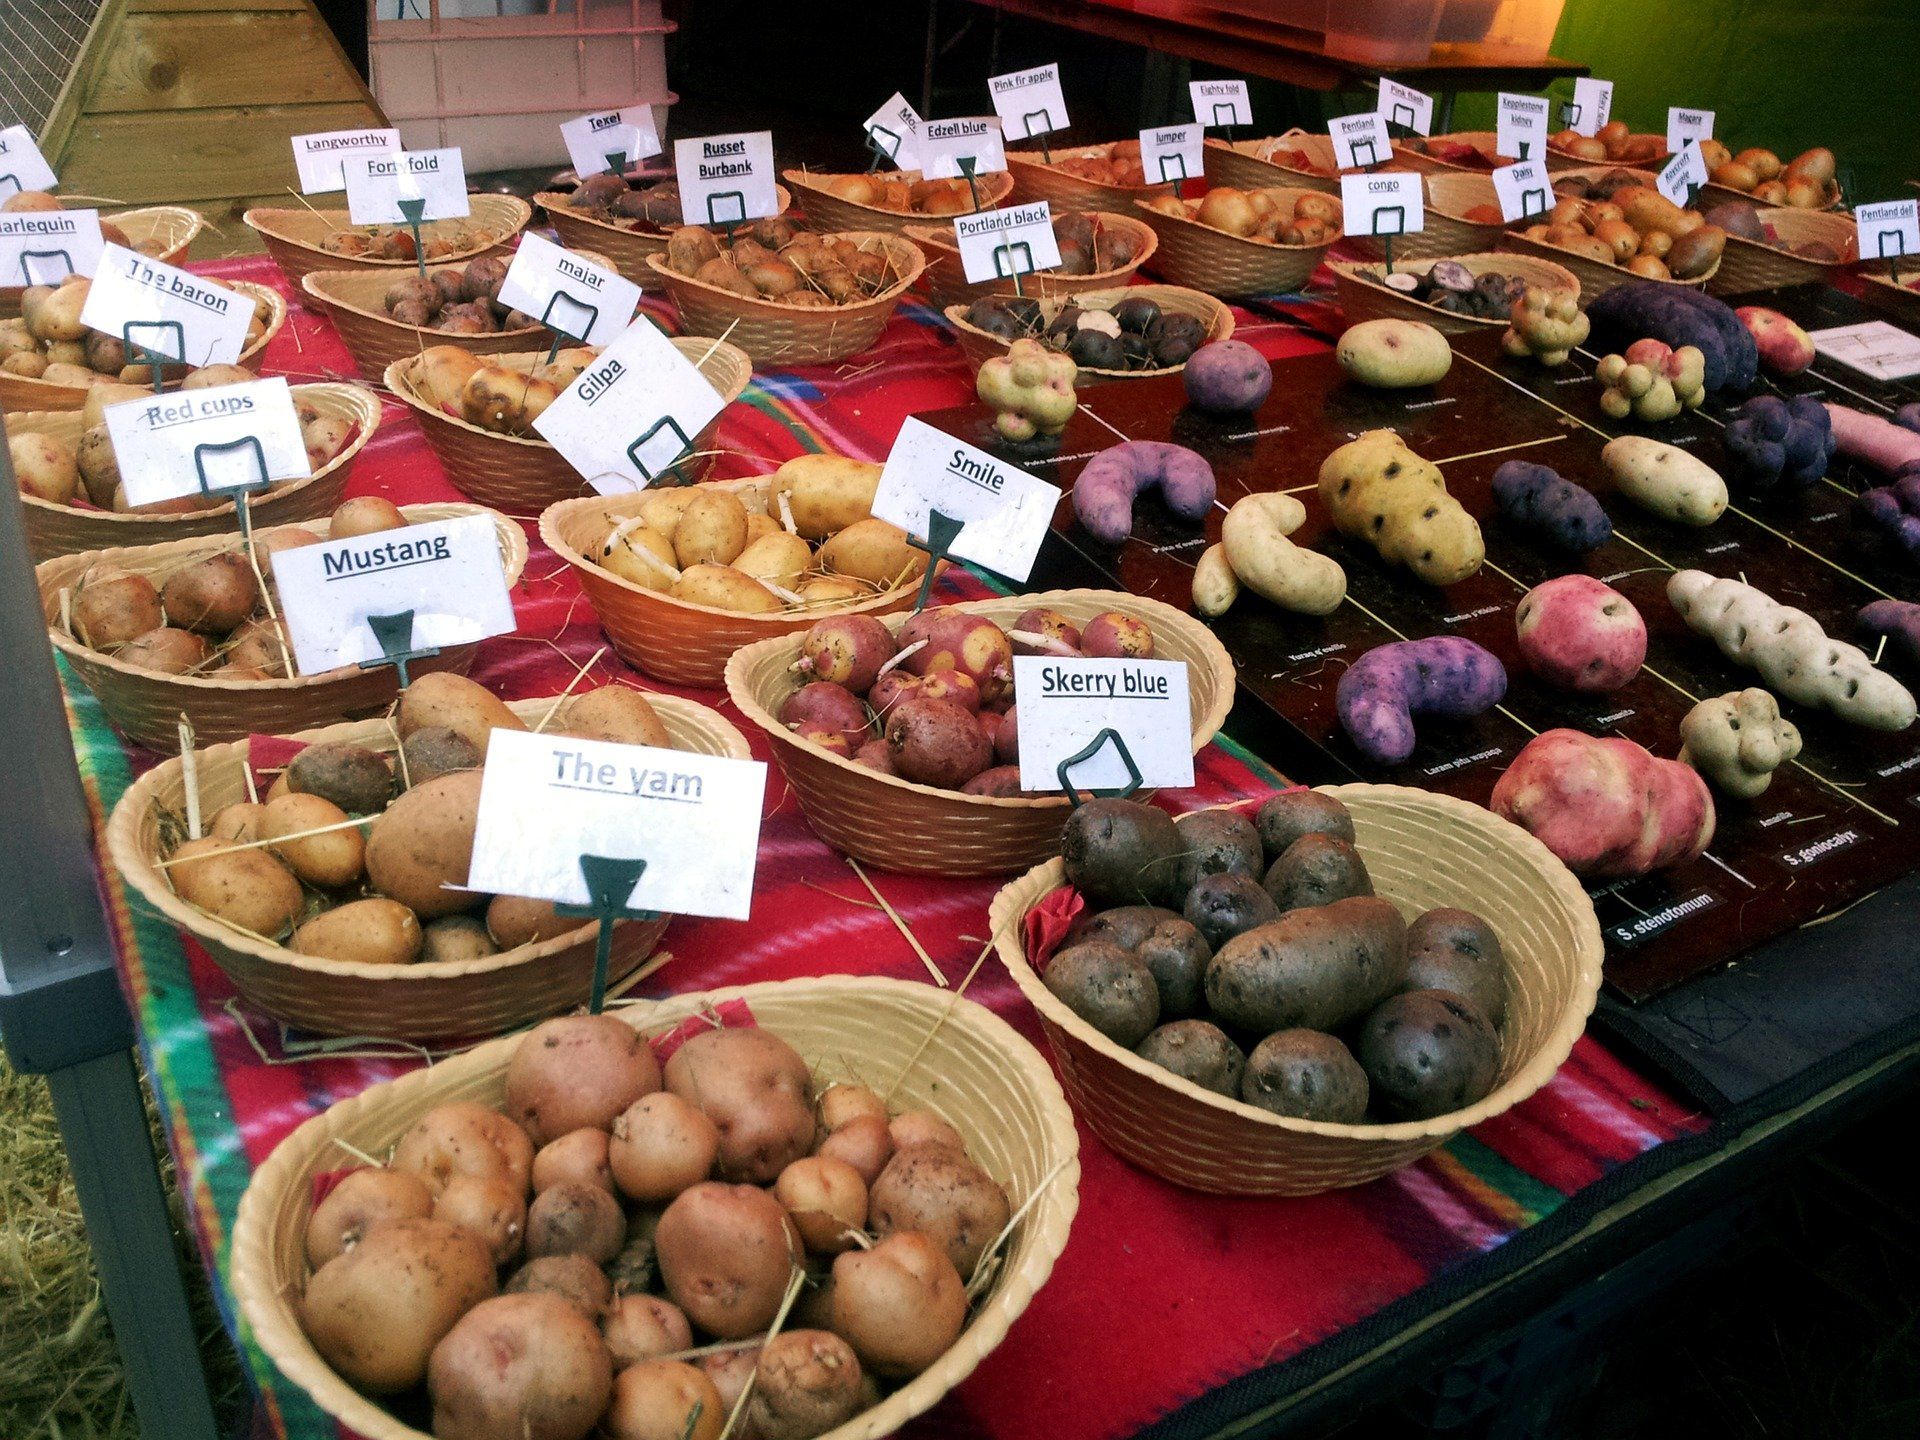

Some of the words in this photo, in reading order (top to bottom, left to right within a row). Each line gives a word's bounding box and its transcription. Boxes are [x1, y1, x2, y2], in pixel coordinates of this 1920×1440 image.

[994, 79, 1013, 91] Pink
[1015, 75, 1025, 86] fir
[1028, 70, 1053, 84] apple
[1200, 85, 1224, 95] Eighty
[1226, 84, 1240, 94] fold
[588, 113, 620, 129] Texel
[928, 123, 960, 137] Edzell
[962, 121, 987, 135] blue
[1341, 118, 1375, 132] Pentland
[305, 134, 387, 149] Langworthy
[703, 140, 745, 156] Russet
[699, 160, 752, 177] Burbank
[1512, 167, 1533, 180] Daisy
[1368, 180, 1399, 192] congo
[960, 213, 1012, 235] Portland
[1014, 206, 1047, 224] black
[1861, 205, 1899, 220] Pentland
[1900, 204, 1914, 216] dell
[558, 257, 605, 288] majar
[131, 259, 166, 286] The
[171, 276, 228, 312] baron
[577, 358, 623, 401] Gilpa
[147, 399, 194, 426] Red
[201, 395, 254, 415] cups
[949, 450, 1004, 489] Smile
[323, 536, 450, 575] Mustang
[1042, 666, 1116, 699] Skerry
[1123, 668, 1168, 694] blue
[553, 750, 617, 785] The
[630, 767, 703, 796] yam
[1423, 762, 1453, 776] Laram
[1783, 853, 1802, 866] S.
[1799, 830, 1859, 863] goniocalyx
[1617, 927, 1637, 941] S.
[1634, 893, 1714, 935] stenotomum
